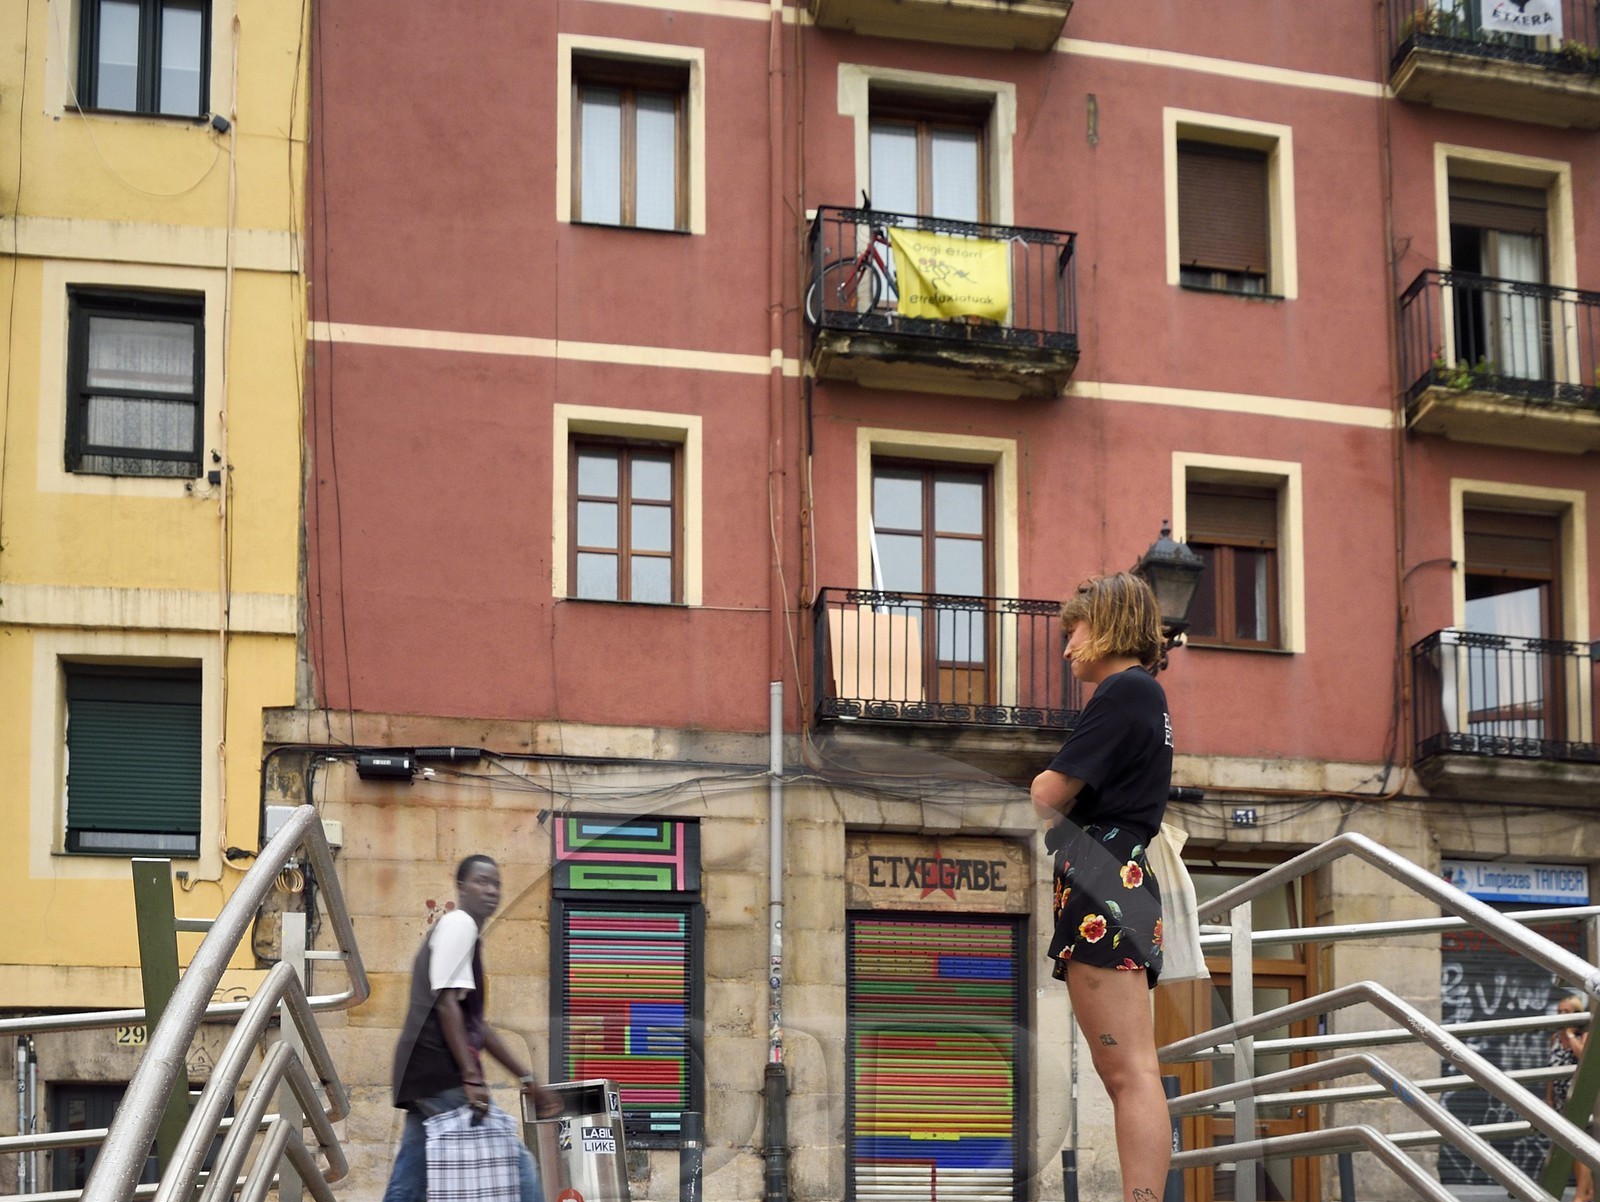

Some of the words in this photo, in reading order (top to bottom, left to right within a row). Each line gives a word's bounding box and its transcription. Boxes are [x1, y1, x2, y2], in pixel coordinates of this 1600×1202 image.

[1492, 8, 1553, 26] ETXERA
[868, 855, 1007, 892] ETXEGABE
[1476, 866, 1531, 891] Limpiezas
[1533, 868, 1584, 891] TANGER
[118, 1026, 146, 1044] 29
[584, 1142, 615, 1152] LINKE
